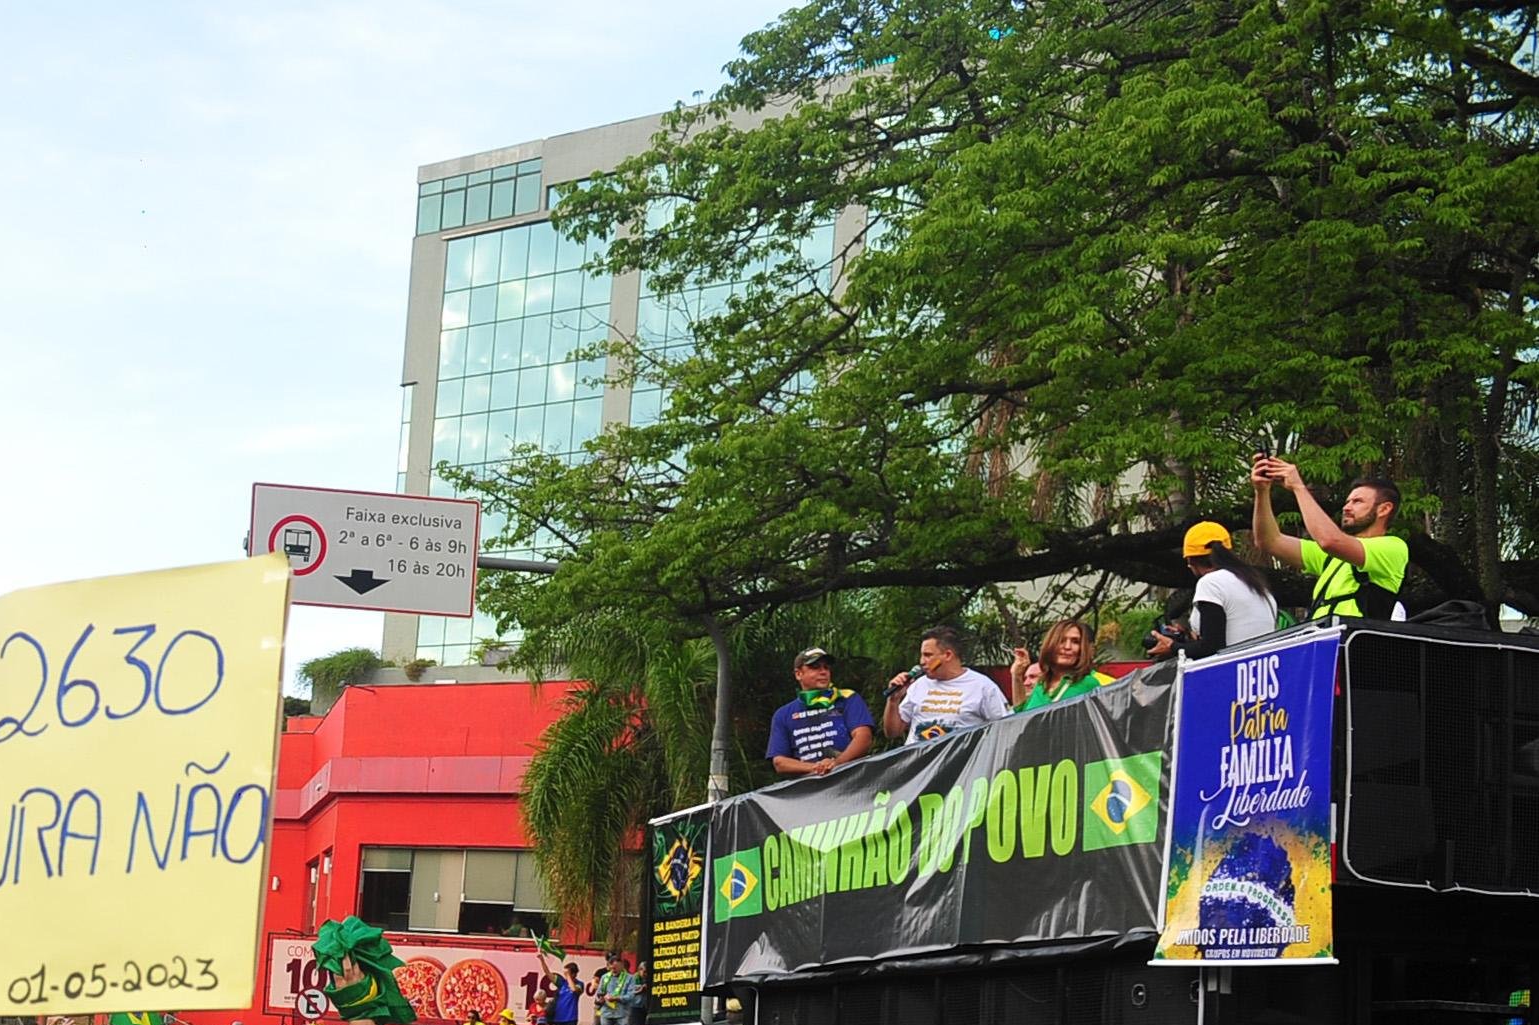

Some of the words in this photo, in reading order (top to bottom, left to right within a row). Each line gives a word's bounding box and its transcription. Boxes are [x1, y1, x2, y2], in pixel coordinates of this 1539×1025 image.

[338, 530, 355, 544] 2ª
[361, 536, 369, 546] a
[375, 534, 392, 547] 6ª
[409, 537, 419, 550] 6
[425, 537, 442, 552] às
[448, 539, 467, 553] 9h
[346, 507, 386, 523] Faixa
[391, 513, 462, 529] exclusiva
[388, 559, 407, 573] 16
[413, 561, 430, 575] às
[436, 563, 465, 578] 20h
[1237, 655, 1280, 705] DEUS
[126, 752, 268, 873] NÃO
[1200, 770, 1312, 830] Liberdade
[763, 790, 913, 912] CAMINHÃO
[918, 785, 964, 878] DO
[964, 759, 1078, 864] POVO
[1176, 928, 1216, 946] UNIDOS
[1218, 928, 1246, 945] PELA
[1249, 925, 1310, 945] LIBERDADE
[8, 956, 221, 1005] 01-05-2023
